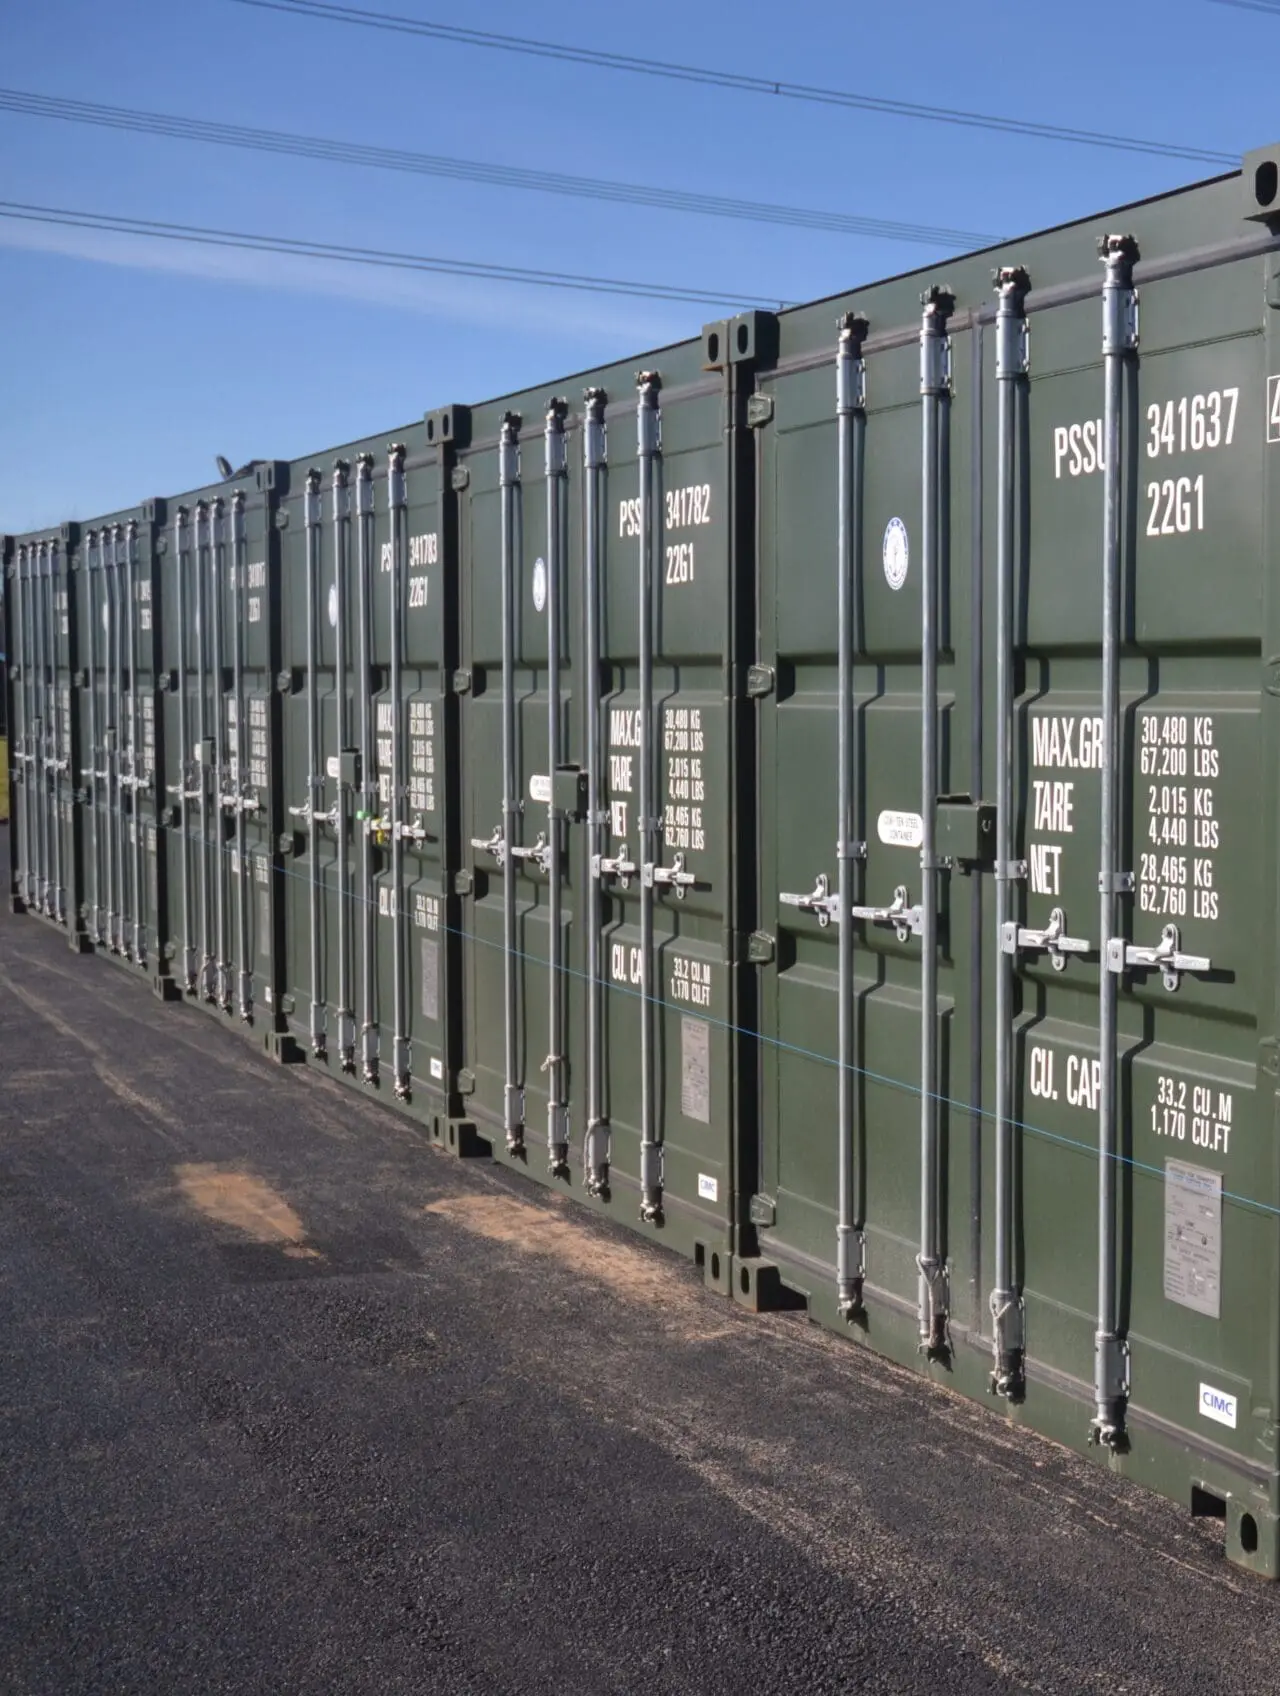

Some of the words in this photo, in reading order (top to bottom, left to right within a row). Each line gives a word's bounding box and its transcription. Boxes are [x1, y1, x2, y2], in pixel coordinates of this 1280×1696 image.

[1147, 387, 1239, 458] 341637
[666, 483, 710, 530] 341782
[1146, 474, 1204, 536] 22G1
[666, 542, 694, 584] 22G1
[1141, 716, 1187, 746] 30,480
[1194, 717, 1212, 745] KG
[610, 755, 632, 792] TARE
[1140, 748, 1187, 776] 67,200
[1194, 749, 1219, 777] LBS
[1033, 781, 1074, 832] TARE
[1149, 785, 1187, 815] 2,015
[1194, 788, 1213, 816] KG
[1149, 817, 1187, 846] 4,440
[1194, 820, 1219, 848] LBS
[1030, 844, 1062, 895] NET
[1140, 853, 1186, 884] 28,465
[1194, 859, 1212, 888] KG
[1140, 884, 1186, 916] 62,760
[1193, 890, 1219, 920] LBS
[1030, 1046, 1058, 1100] CU.
[1158, 1076, 1186, 1110] 33.2
[1193, 1086, 1232, 1123] CU.M
[1151, 1104, 1185, 1140] 1,170
[1192, 1117, 1231, 1154] CU.FT
[1203, 1391, 1233, 1417] CIMC
